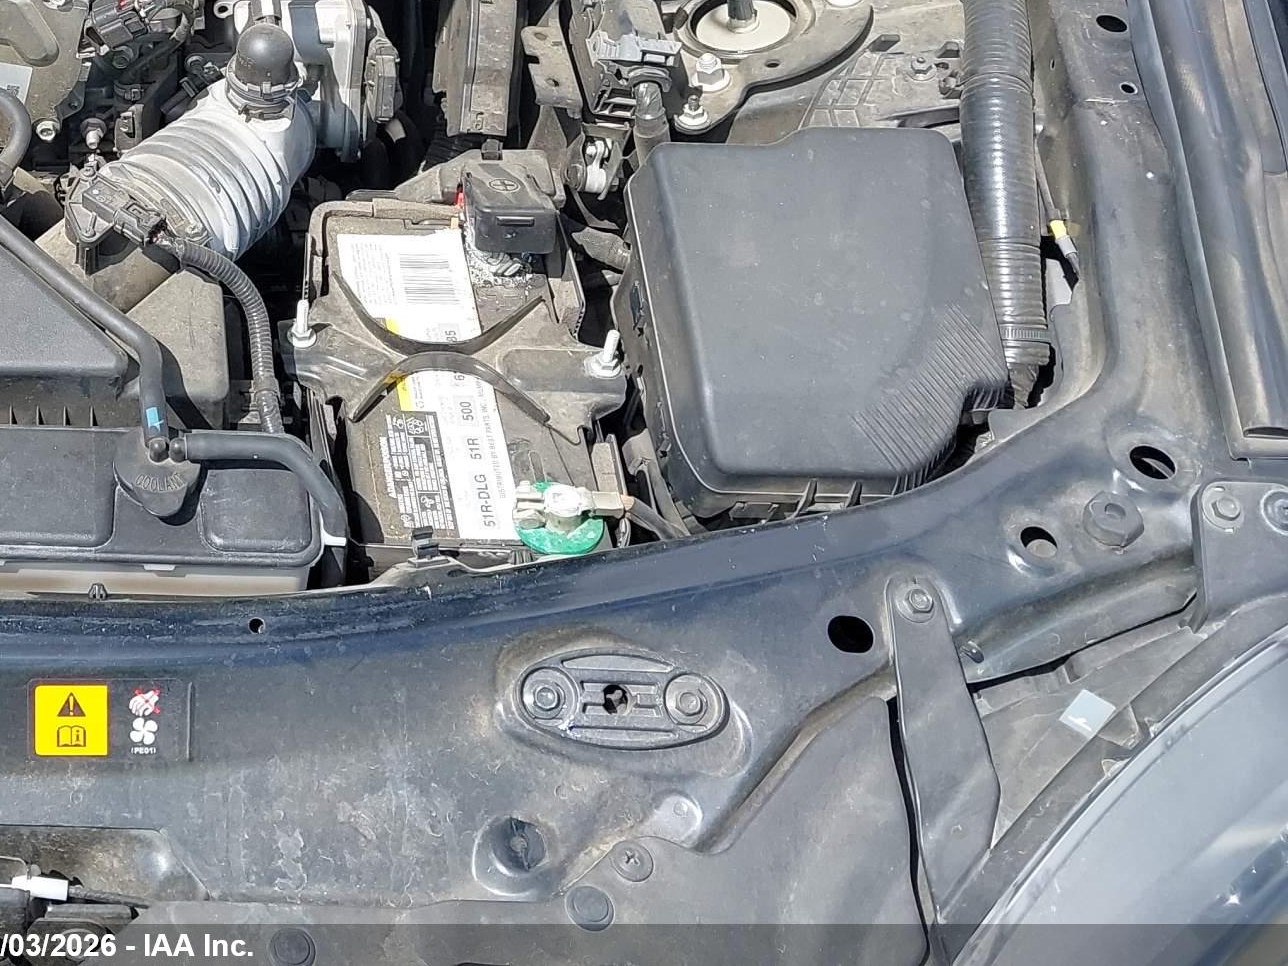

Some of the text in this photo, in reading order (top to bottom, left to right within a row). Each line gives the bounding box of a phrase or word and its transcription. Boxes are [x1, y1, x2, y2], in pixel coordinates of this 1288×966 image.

[460, 401, 474, 422] 500
[467, 437, 482, 460] 51R
[135, 472, 185, 493] COOLANT
[474, 473, 496, 528] 51R-DLG
